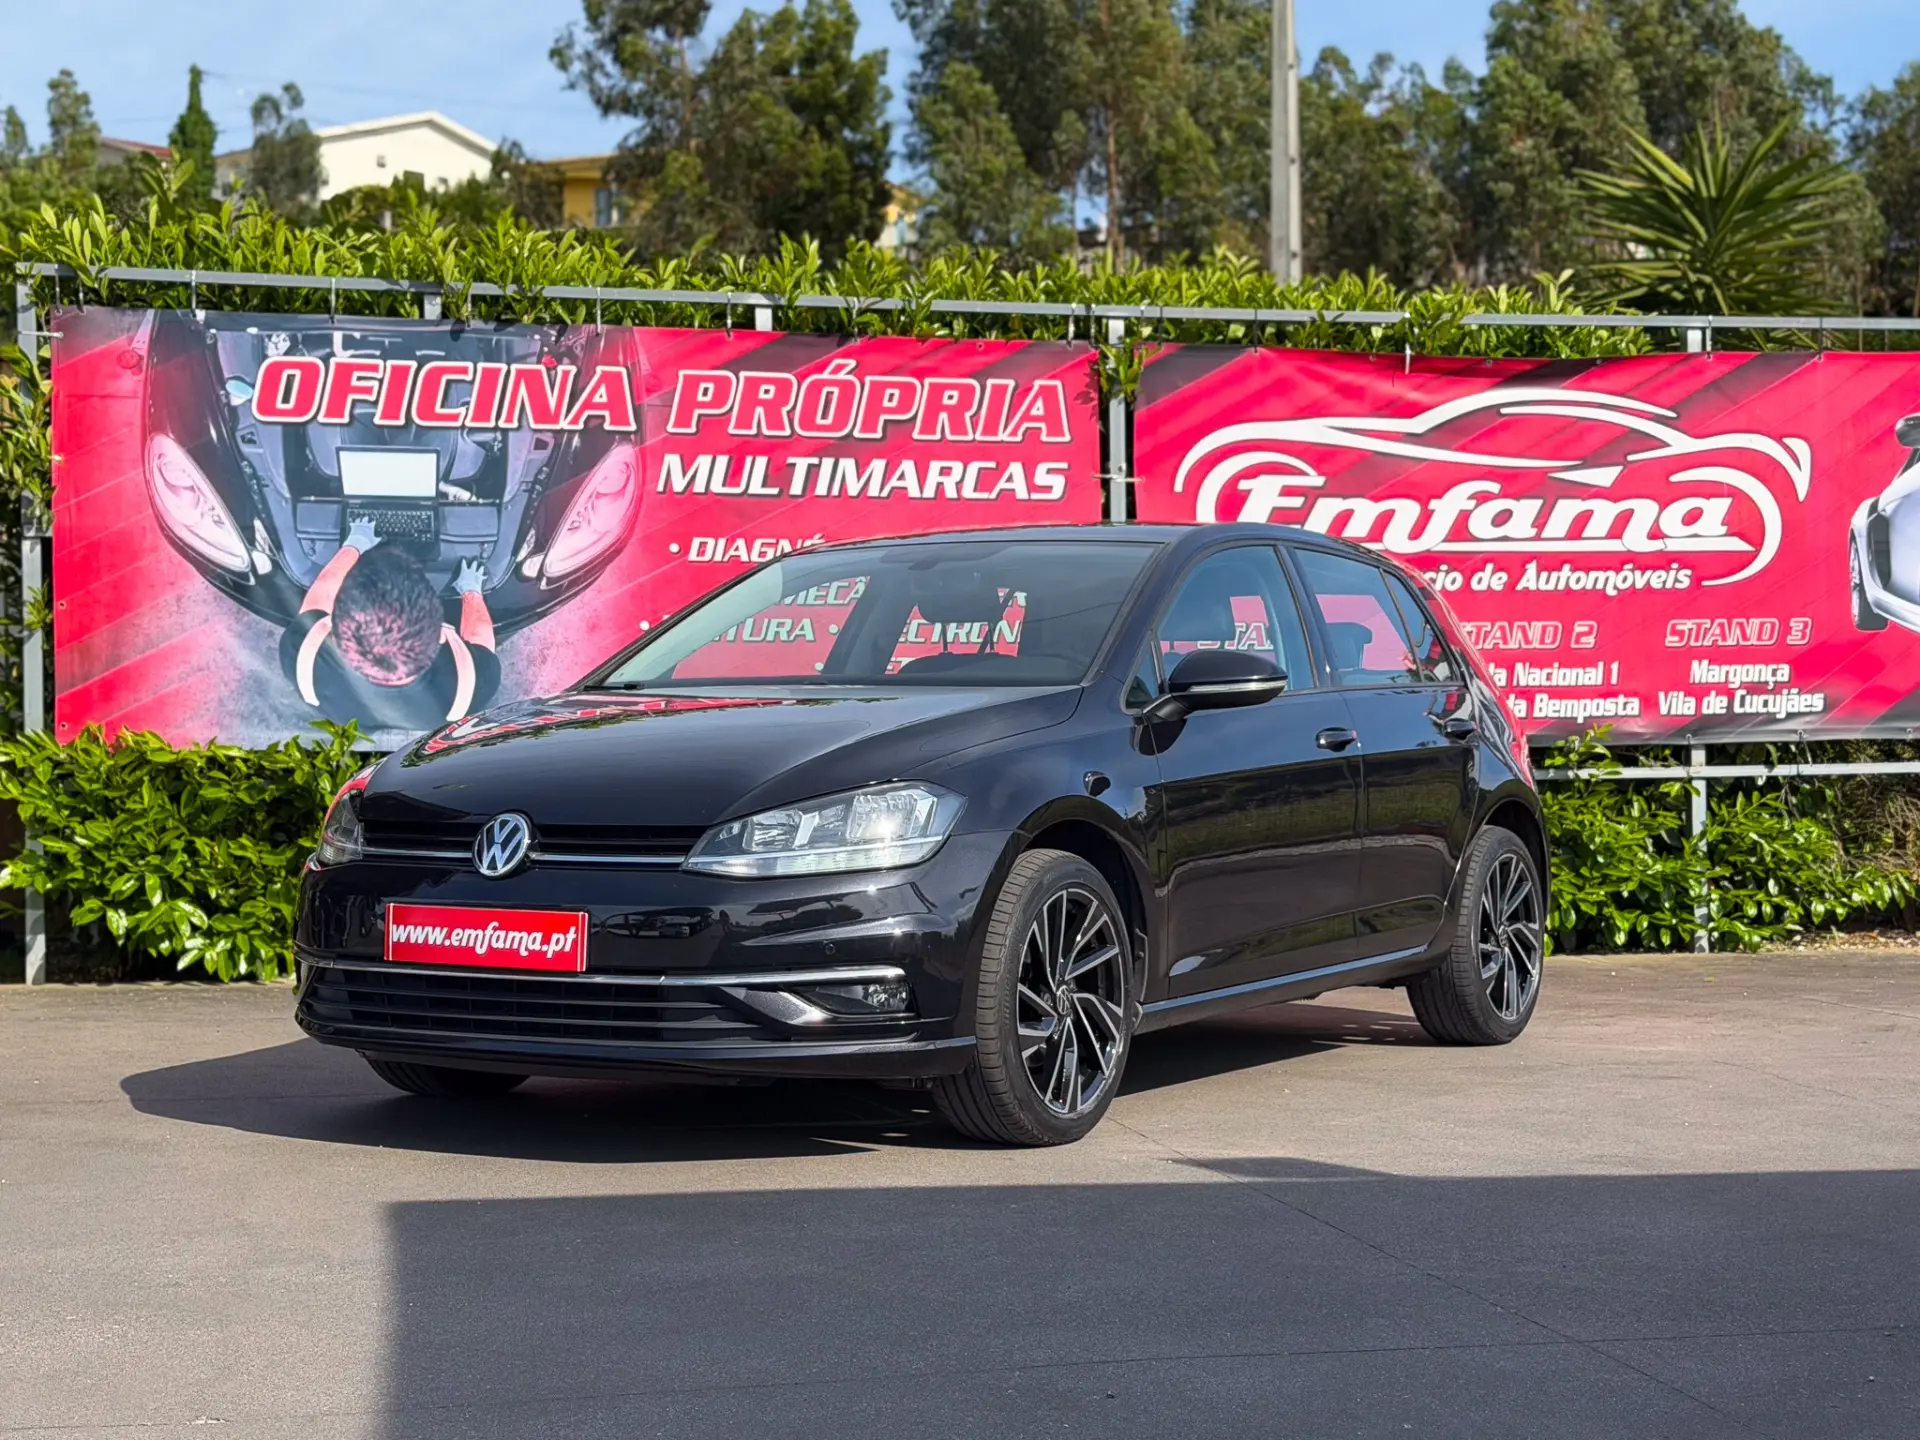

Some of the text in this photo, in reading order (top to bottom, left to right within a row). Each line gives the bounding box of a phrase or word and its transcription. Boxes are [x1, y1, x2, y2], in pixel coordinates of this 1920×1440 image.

[251, 357, 1072, 443] OFICINA PRÓPRIA
[656, 453, 1068, 500] MULTIMARCAS
[1237, 475, 1733, 552] Emfama
[1470, 563, 1508, 591] de
[1516, 559, 1693, 596] Automóveis
[1460, 620, 1598, 649] TAND 2
[1665, 617, 1813, 647] STAND 3
[1512, 661, 1604, 687] Nacional
[1609, 661, 1620, 685] 1
[1690, 659, 1791, 690] Margonça
[1532, 693, 1640, 724] Bemposta
[1658, 691, 1697, 716] Vila
[1701, 690, 1727, 715] de
[392, 921, 577, 958] www.emfama.pt
